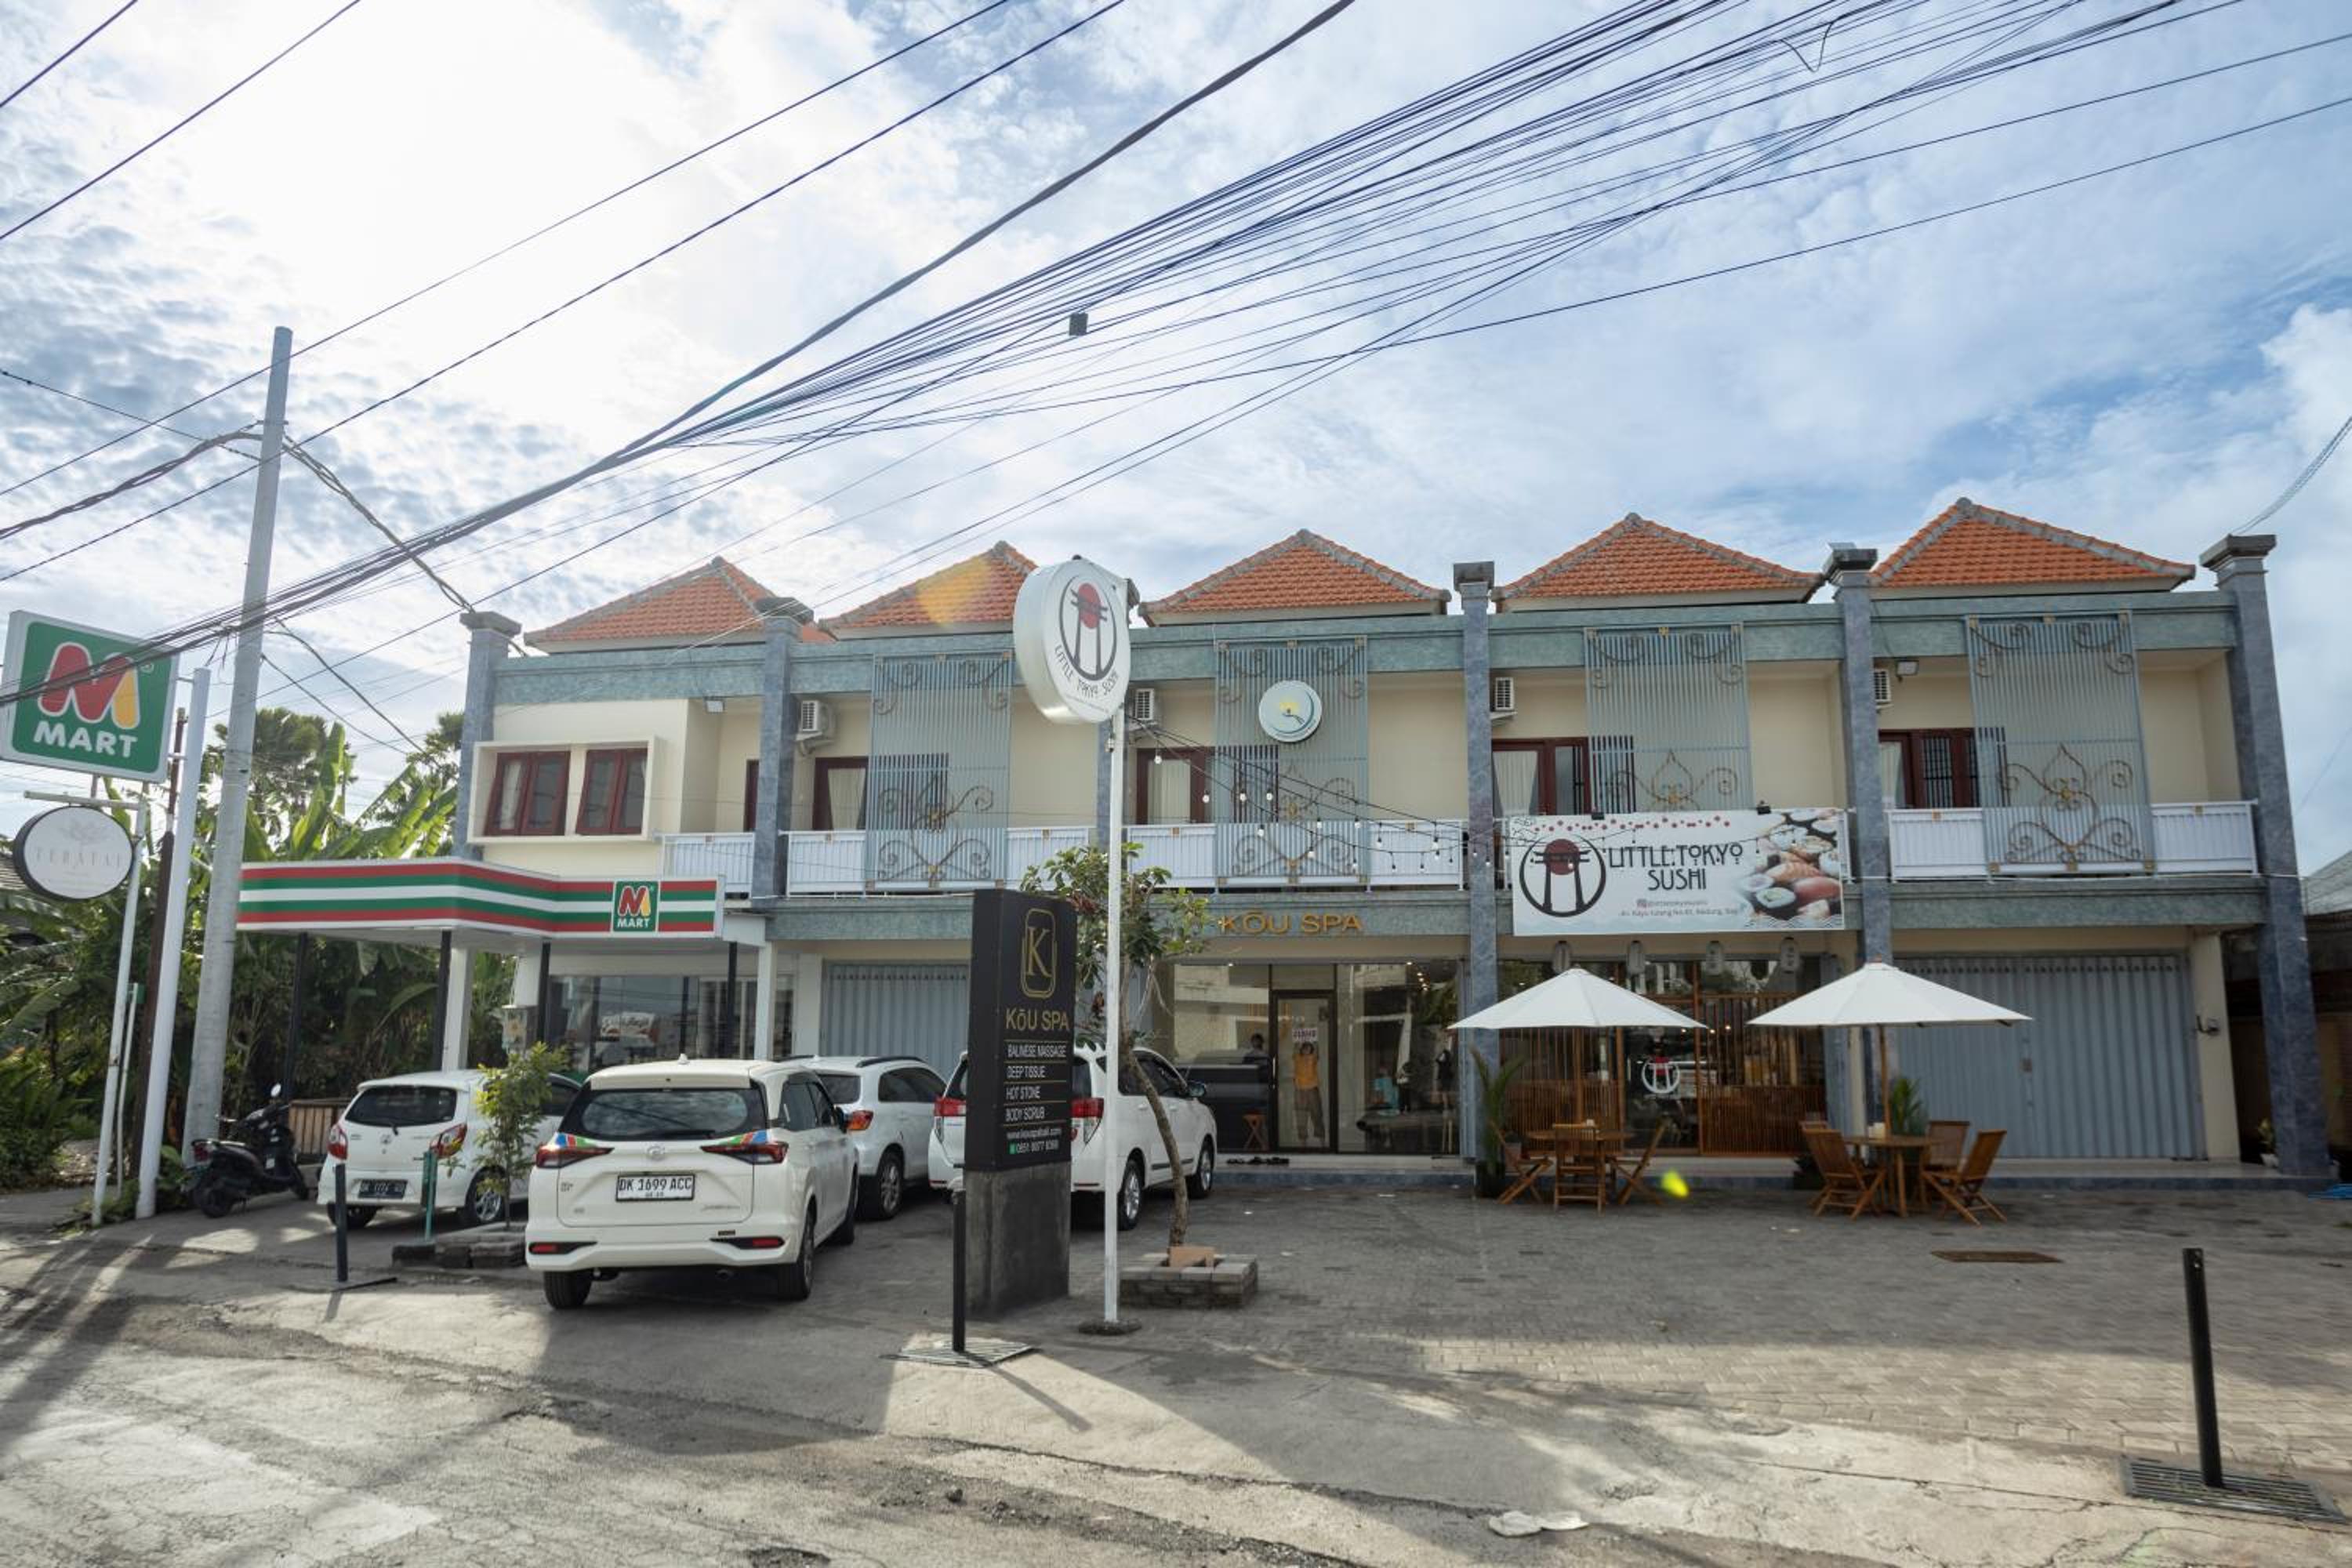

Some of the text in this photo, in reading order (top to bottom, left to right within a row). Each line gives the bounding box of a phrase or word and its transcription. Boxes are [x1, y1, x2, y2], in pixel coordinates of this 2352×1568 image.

[1054, 644, 1073, 683] LITTLE
[34, 720, 138, 758] MART
[1648, 869, 1707, 891] SUSHI
[617, 918, 650, 928] MART
[1302, 913, 1363, 935] SPA
[1026, 926, 1052, 978] K
[1040, 1009, 1070, 1032] SPA
[1007, 1044, 1067, 1058] BALINESE MASSAGE
[1007, 1065, 1046, 1079] DEEP TISSUE
[1006, 1085, 1040, 1100] HOT STONE
[1006, 1105, 1045, 1122] BODY SCRUB
[619, 1177, 692, 1191] DK 1699 ACC
